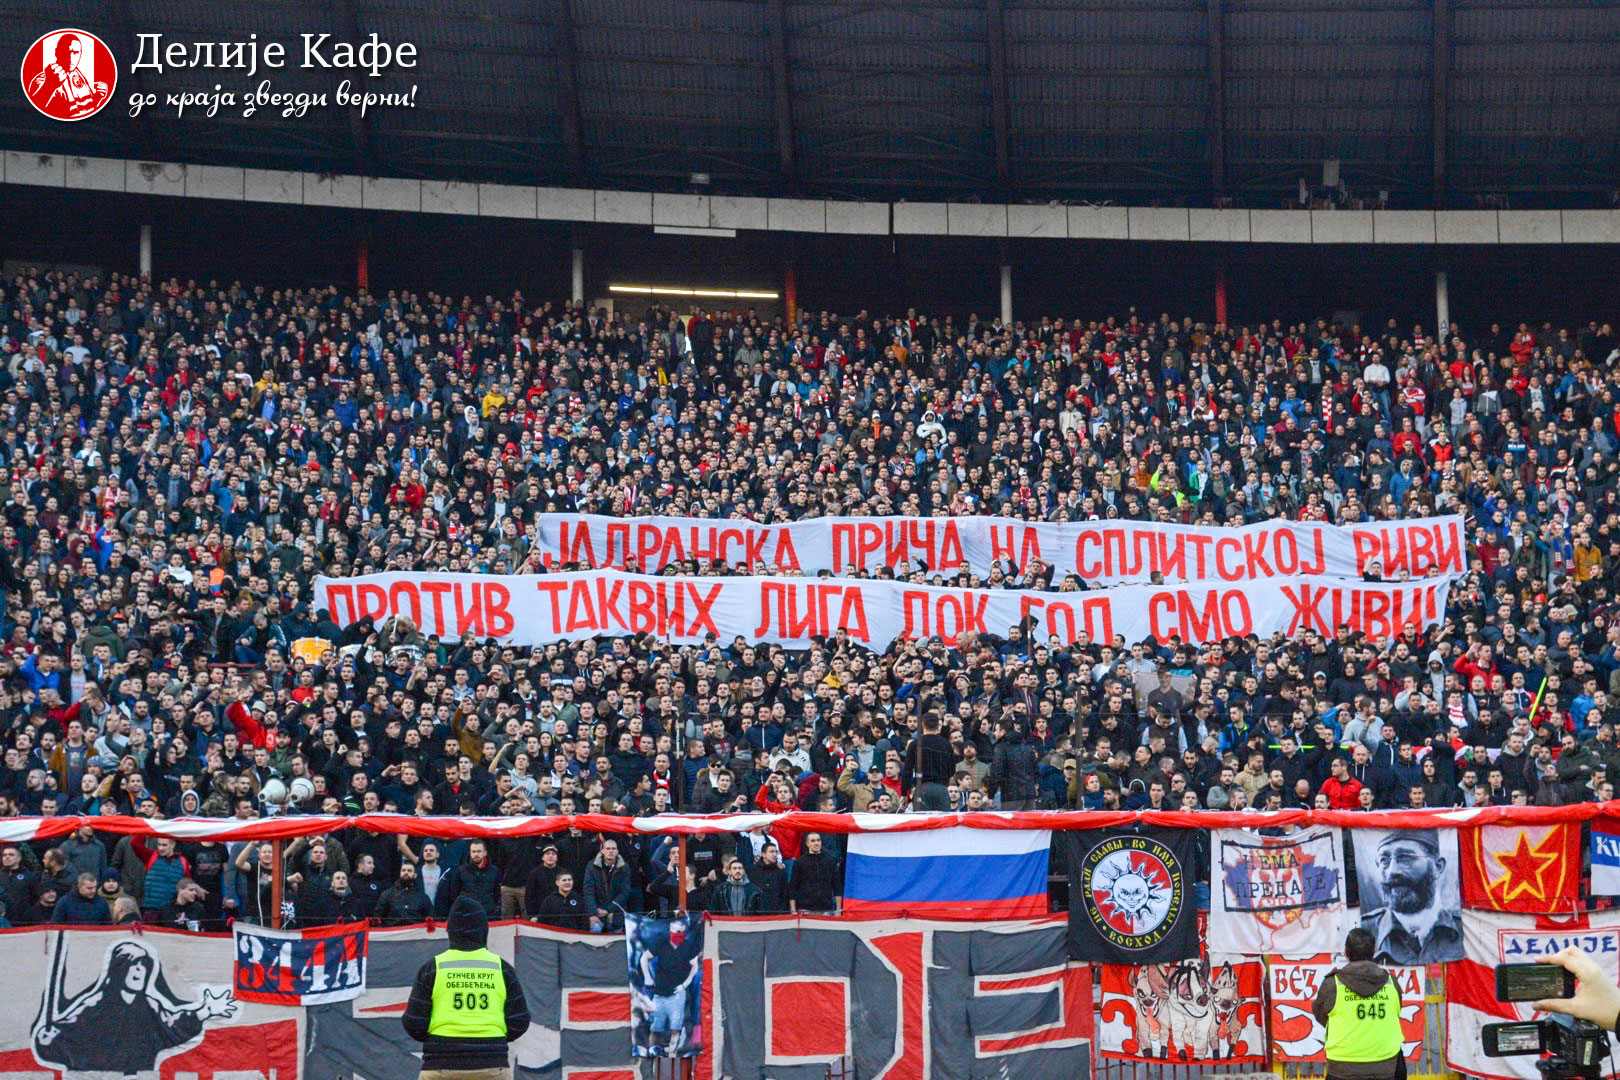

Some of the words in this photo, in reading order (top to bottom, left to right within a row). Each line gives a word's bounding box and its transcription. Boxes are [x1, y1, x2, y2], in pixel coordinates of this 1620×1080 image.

[543, 520, 802, 573] ЈАДРАНСКА
[832, 519, 966, 574] ПРИЧА
[990, 524, 1046, 576] НА
[1076, 527, 1326, 582] СПЛИТСКОЈ
[1353, 521, 1464, 578] РИВИ
[326, 580, 515, 637] ПРОТИВ
[537, 576, 723, 639] ТАКВИХ
[754, 581, 871, 643] ЛИГА
[903, 589, 989, 648] ДОК
[1149, 588, 1253, 645] СМО
[1132, 839, 1146, 849] ВО
[1243, 853, 1301, 870] НЕМА
[1236, 872, 1327, 899] ПРЕДАЈЕ
[1109, 930, 1162, 947] ВОСХОД
[447, 972, 476, 980] СУНЧЕВ
[477, 972, 495, 980] КРУГ
[453, 993, 489, 1010] 503
[1357, 1003, 1386, 1020] 645
